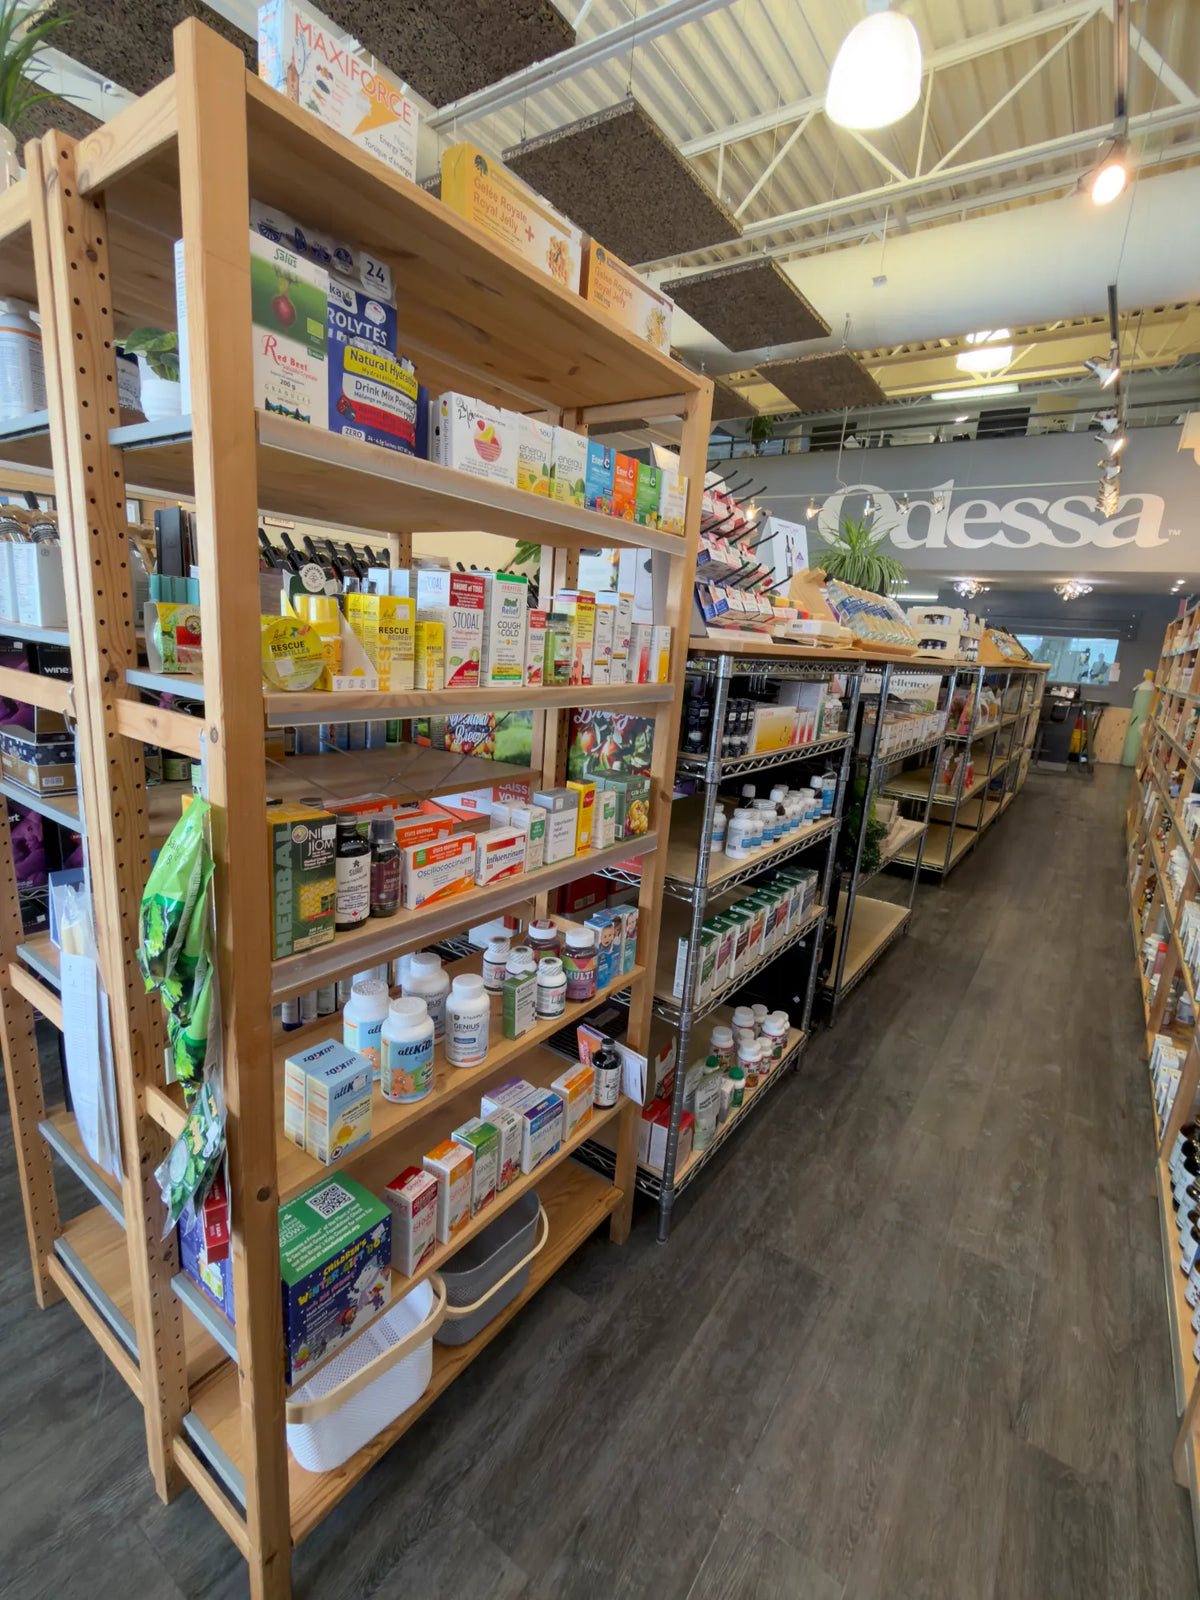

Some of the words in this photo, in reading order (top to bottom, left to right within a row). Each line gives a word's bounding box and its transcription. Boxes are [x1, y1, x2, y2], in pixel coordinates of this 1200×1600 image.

[295, 13, 412, 126] MAXIFORCE
[379, 134, 400, 155] Energy
[473, 177, 498, 202] Gelée
[500, 194, 528, 224] Royale
[472, 191, 498, 218] Royal
[499, 211, 520, 233] Jelly
[273, 248, 298, 268] Salus
[366, 260, 386, 283] 24
[327, 307, 388, 346] ROLYTES
[261, 333, 289, 366] Red
[290, 358, 309, 373] Beet
[350, 349, 389, 373] Natural
[388, 364, 418, 391] Hydration
[354, 379, 381, 399] Drink
[381, 389, 395, 403] Mix
[344, 427, 363, 439] ZERO
[519, 443, 547, 462] energy
[557, 455, 583, 472] energy
[817, 478, 1170, 549] Odessa
[378, 626, 409, 635] RESCUE
[452, 611, 480, 630] STODAL
[496, 620, 522, 630] COUGH
[500, 629, 520, 638] COLD
[270, 641, 305, 653] RESCUE
[307, 838, 334, 857] JIOM
[486, 848, 525, 865] Influenzinum
[416, 855, 472, 879] Oscillococcinum
[274, 822, 293, 960] HERBAL
[566, 970, 594, 982] MULTI
[453, 1022, 480, 1031] GENIUS
[322, 1238, 367, 1277] CHILDREN'S
[297, 1268, 340, 1306] WINTER
[342, 1248, 365, 1273] GIFT
